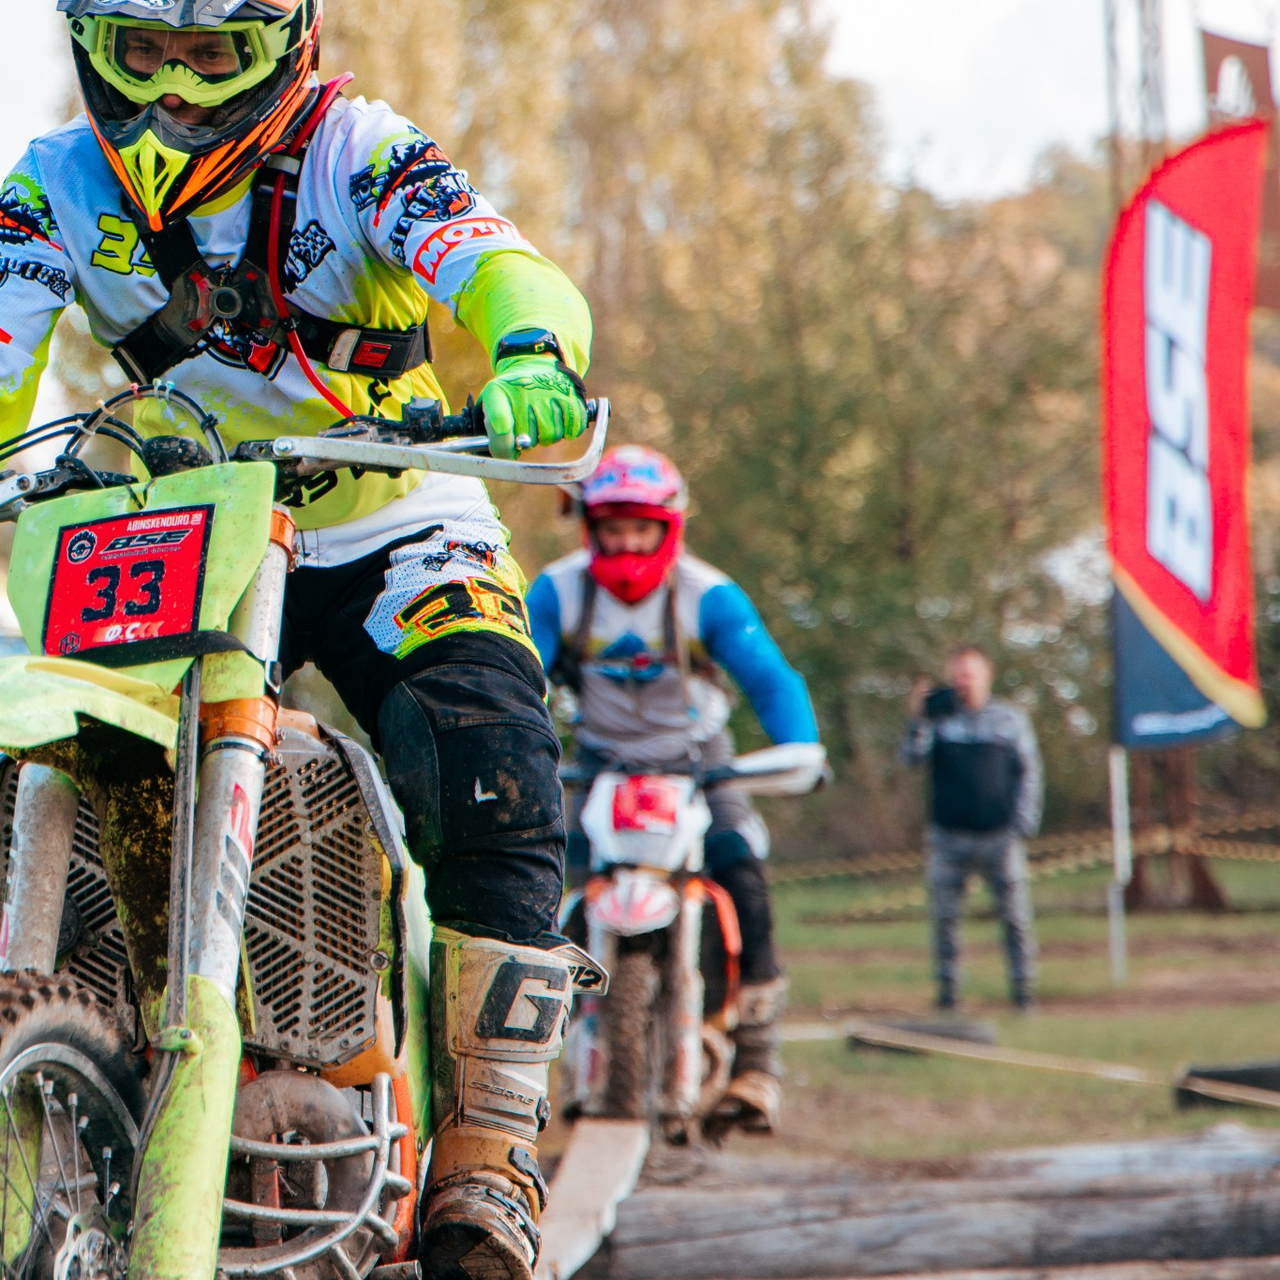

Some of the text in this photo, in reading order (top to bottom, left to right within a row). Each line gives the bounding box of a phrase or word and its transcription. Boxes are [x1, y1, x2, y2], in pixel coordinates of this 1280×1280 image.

[91, 212, 157, 278] 3
[1142, 198, 1214, 603] BSE
[99, 528, 194, 555] BSE
[81, 559, 166, 623] 33
[474, 961, 570, 1045] G
